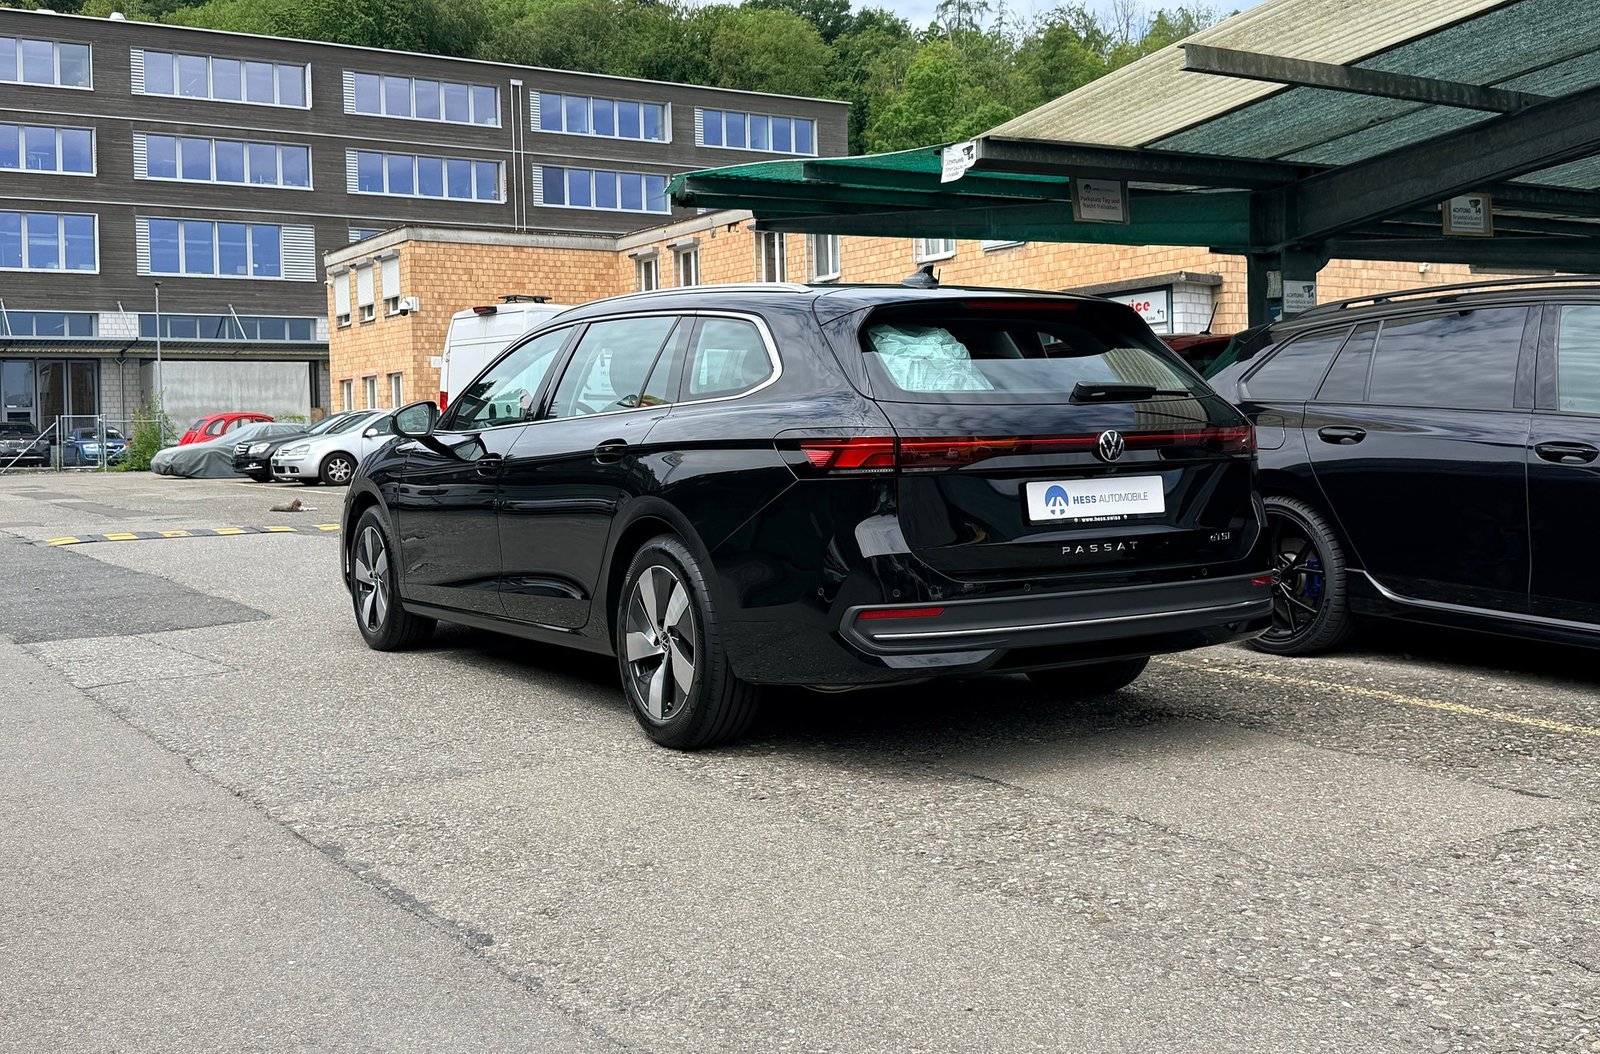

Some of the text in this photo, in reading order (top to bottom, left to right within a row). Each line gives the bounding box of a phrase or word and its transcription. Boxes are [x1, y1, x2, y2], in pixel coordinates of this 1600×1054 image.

[1073, 491, 1148, 505] HESS AUTOMOBILE
[1210, 531, 1230, 541] eTSI
[1062, 541, 1138, 555] PASSAT
